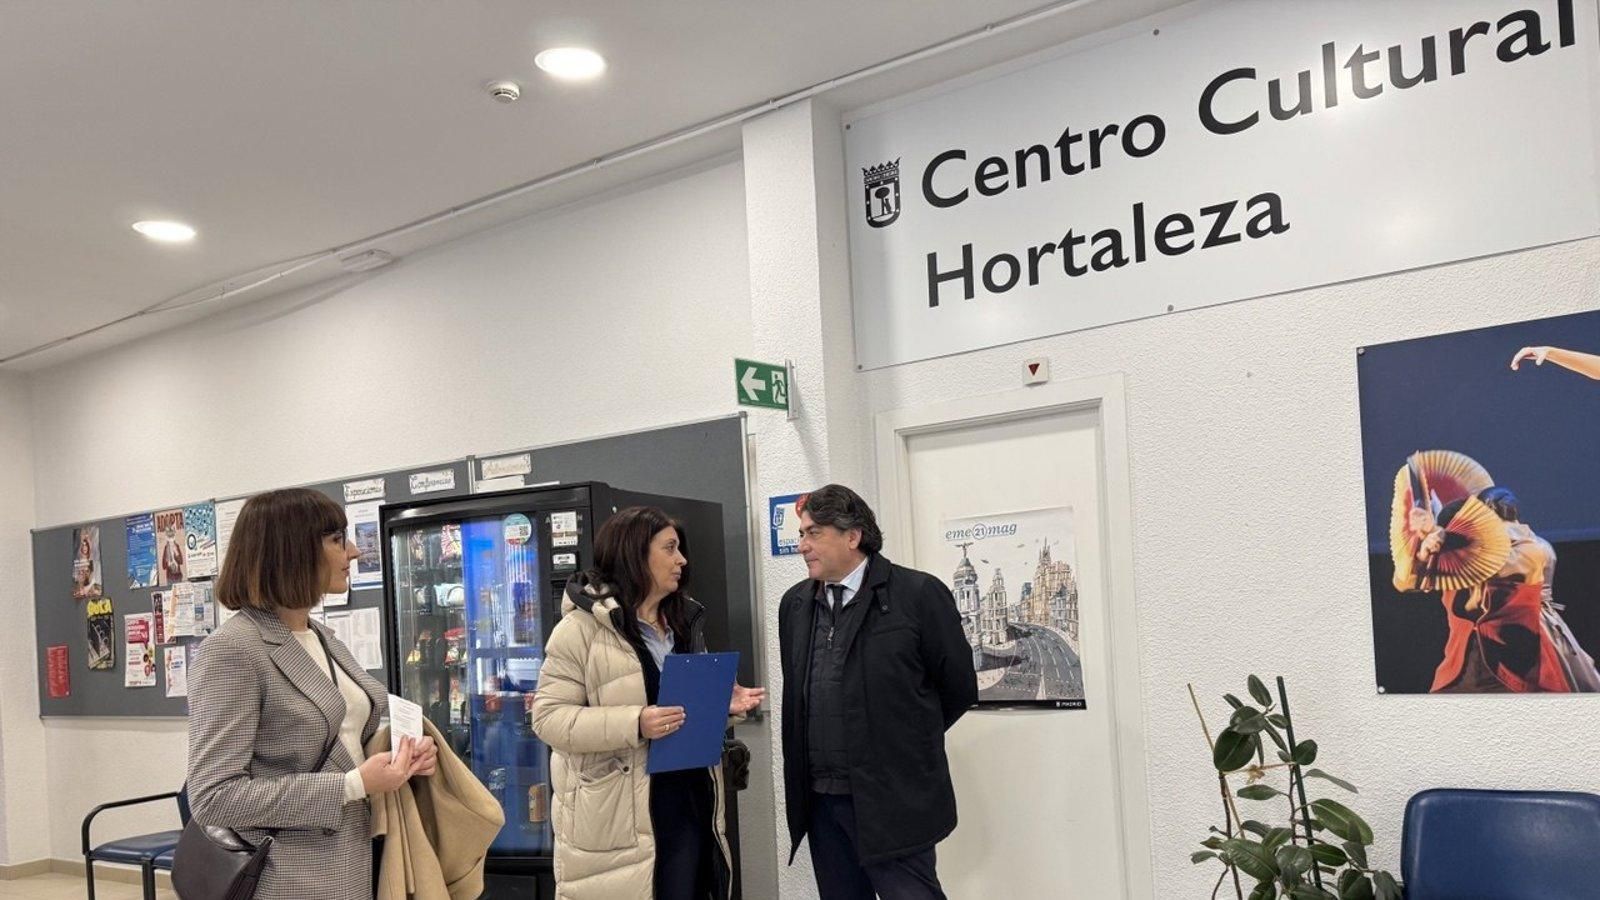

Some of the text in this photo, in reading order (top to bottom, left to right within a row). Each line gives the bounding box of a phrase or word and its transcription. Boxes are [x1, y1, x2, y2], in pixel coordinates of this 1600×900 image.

[921, 0, 1575, 208] Centro Cultural
[926, 192, 1291, 307] Hortaleza
